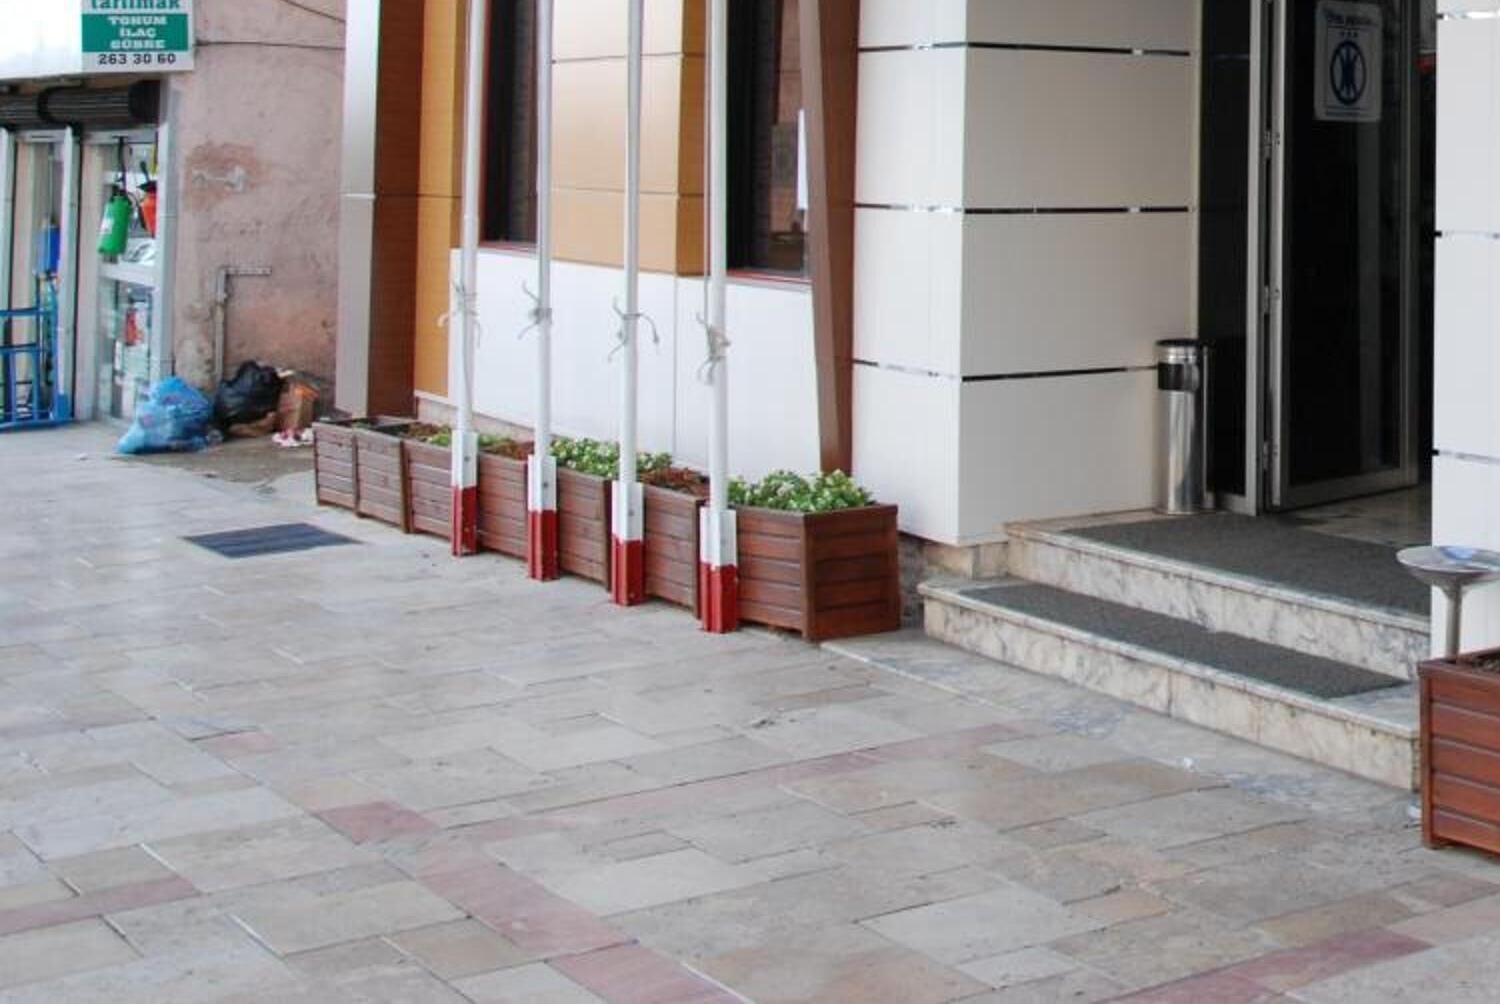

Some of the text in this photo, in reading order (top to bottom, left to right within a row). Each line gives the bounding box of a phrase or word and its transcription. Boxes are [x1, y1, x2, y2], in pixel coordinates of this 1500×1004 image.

[98, 53, 177, 65] 263 30 60
